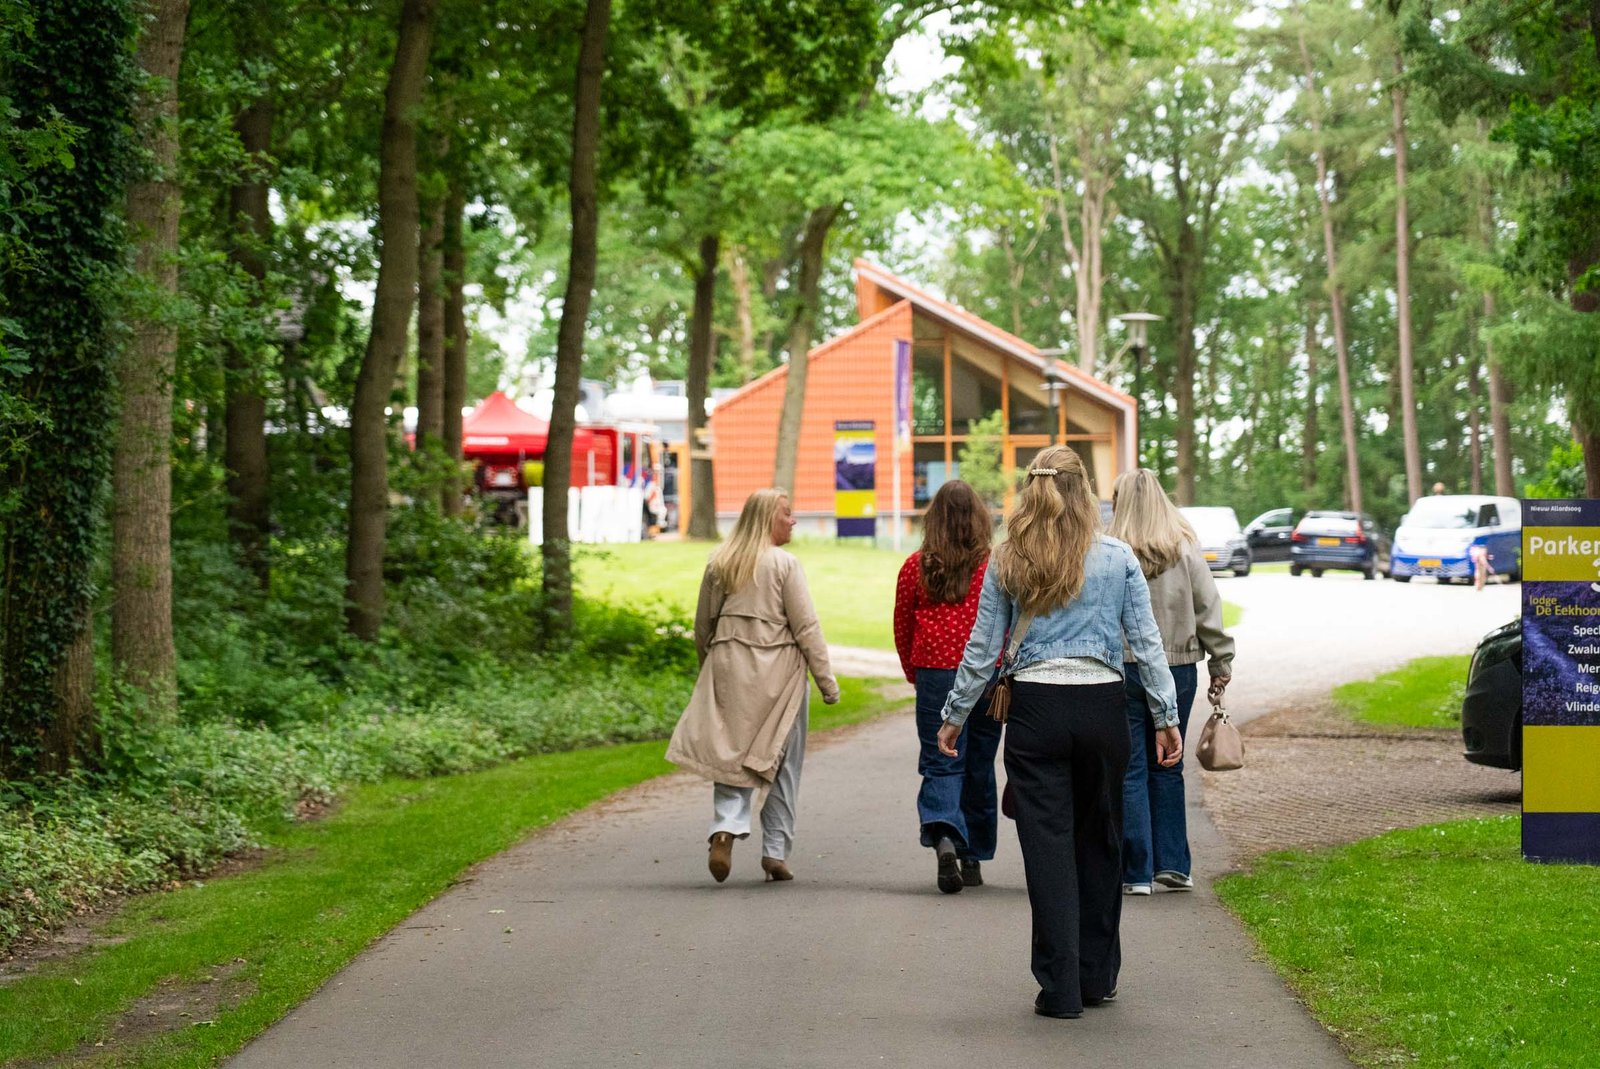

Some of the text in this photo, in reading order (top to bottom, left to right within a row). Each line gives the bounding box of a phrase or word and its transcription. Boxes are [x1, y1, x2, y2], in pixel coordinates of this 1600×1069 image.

[1529, 595, 1557, 606] lodge
[1536, 604, 1552, 616] De
[1568, 644, 1600, 655] Zwalu
[1577, 663, 1600, 674] Mer
[1576, 682, 1600, 695] Reig
[1565, 701, 1600, 712] Vlinde
